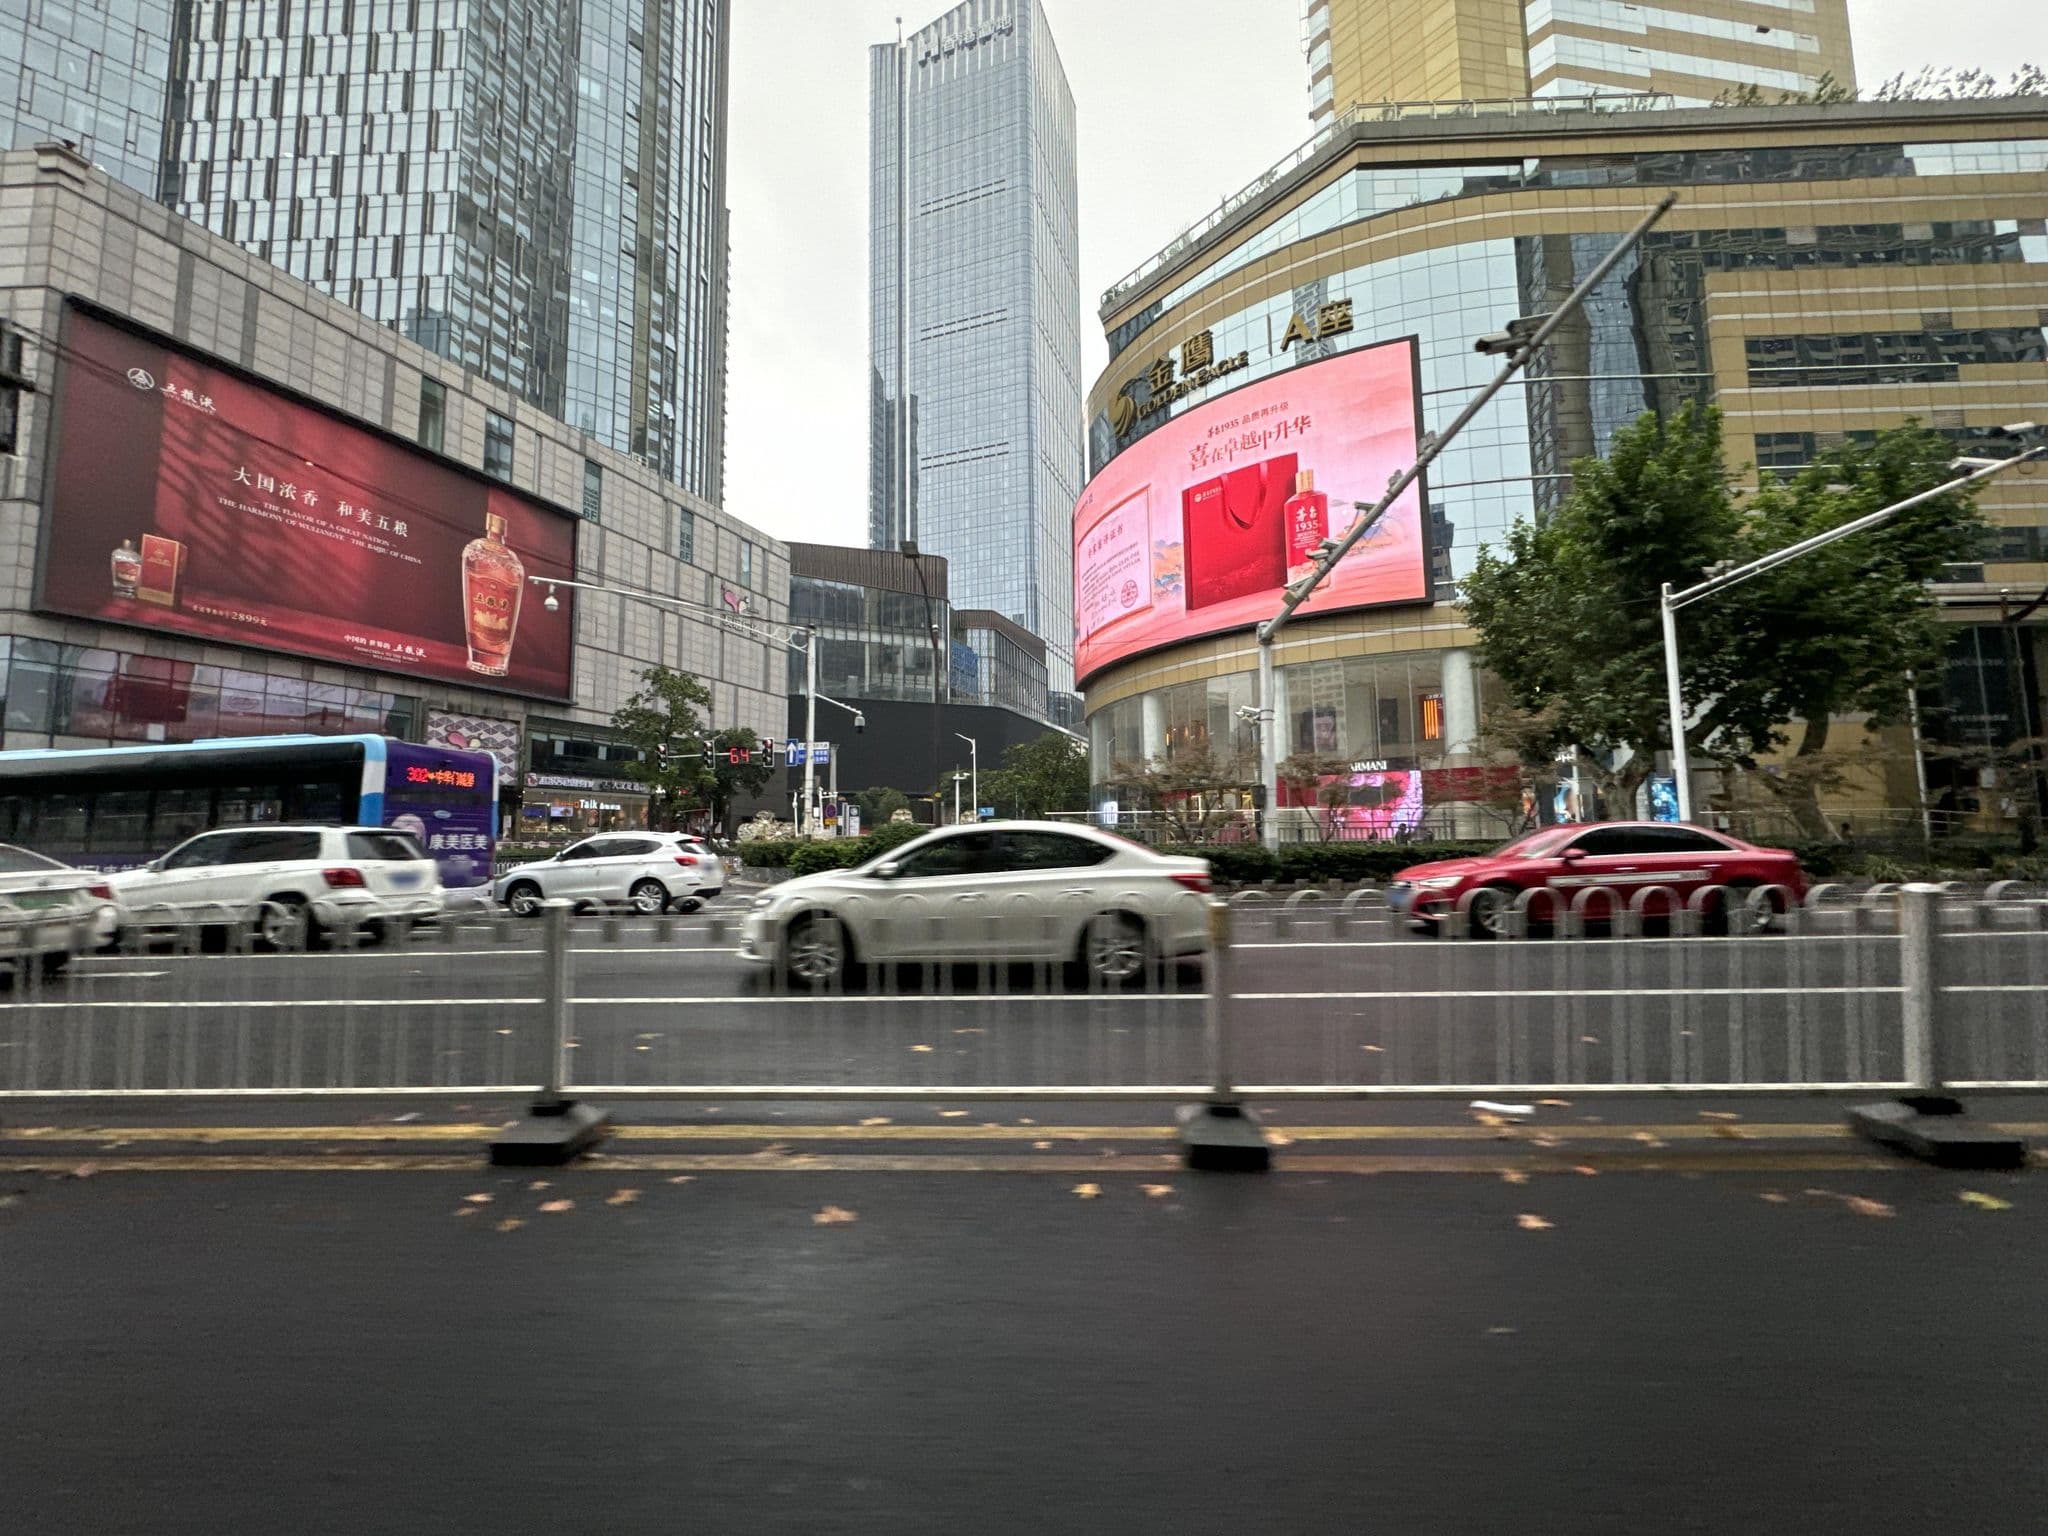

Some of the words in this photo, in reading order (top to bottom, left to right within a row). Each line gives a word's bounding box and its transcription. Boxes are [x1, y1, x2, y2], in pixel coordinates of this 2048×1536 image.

[1279, 298, 1354, 352] A座
[1139, 375, 1197, 419] GOLDEN
[1196, 350, 1250, 388] EAGLE
[1148, 329, 1214, 397] 金鹰
[159, 382, 217, 412] 五粮液
[1187, 412, 1313, 472] 喜在卓越中升华
[232, 465, 320, 507] 大国浓香
[336, 500, 410, 538] 和美五粮
[264, 502, 281, 513] THE
[283, 508, 315, 523] FLAVOR
[316, 517, 328, 526] OF
[336, 524, 360, 537] GREAT
[361, 533, 390, 547] NATION
[1295, 519, 1319, 533] 1935
[217, 496, 238, 508] THE
[239, 502, 285, 524] HARMONY
[285, 518, 297, 527] OF
[299, 523, 345, 541] WULIANGYE
[351, 538, 366, 548] THE
[400, 553, 422, 565] CHINA
[730, 748, 749, 764] 64
[428, 833, 488, 850] 康美医美
